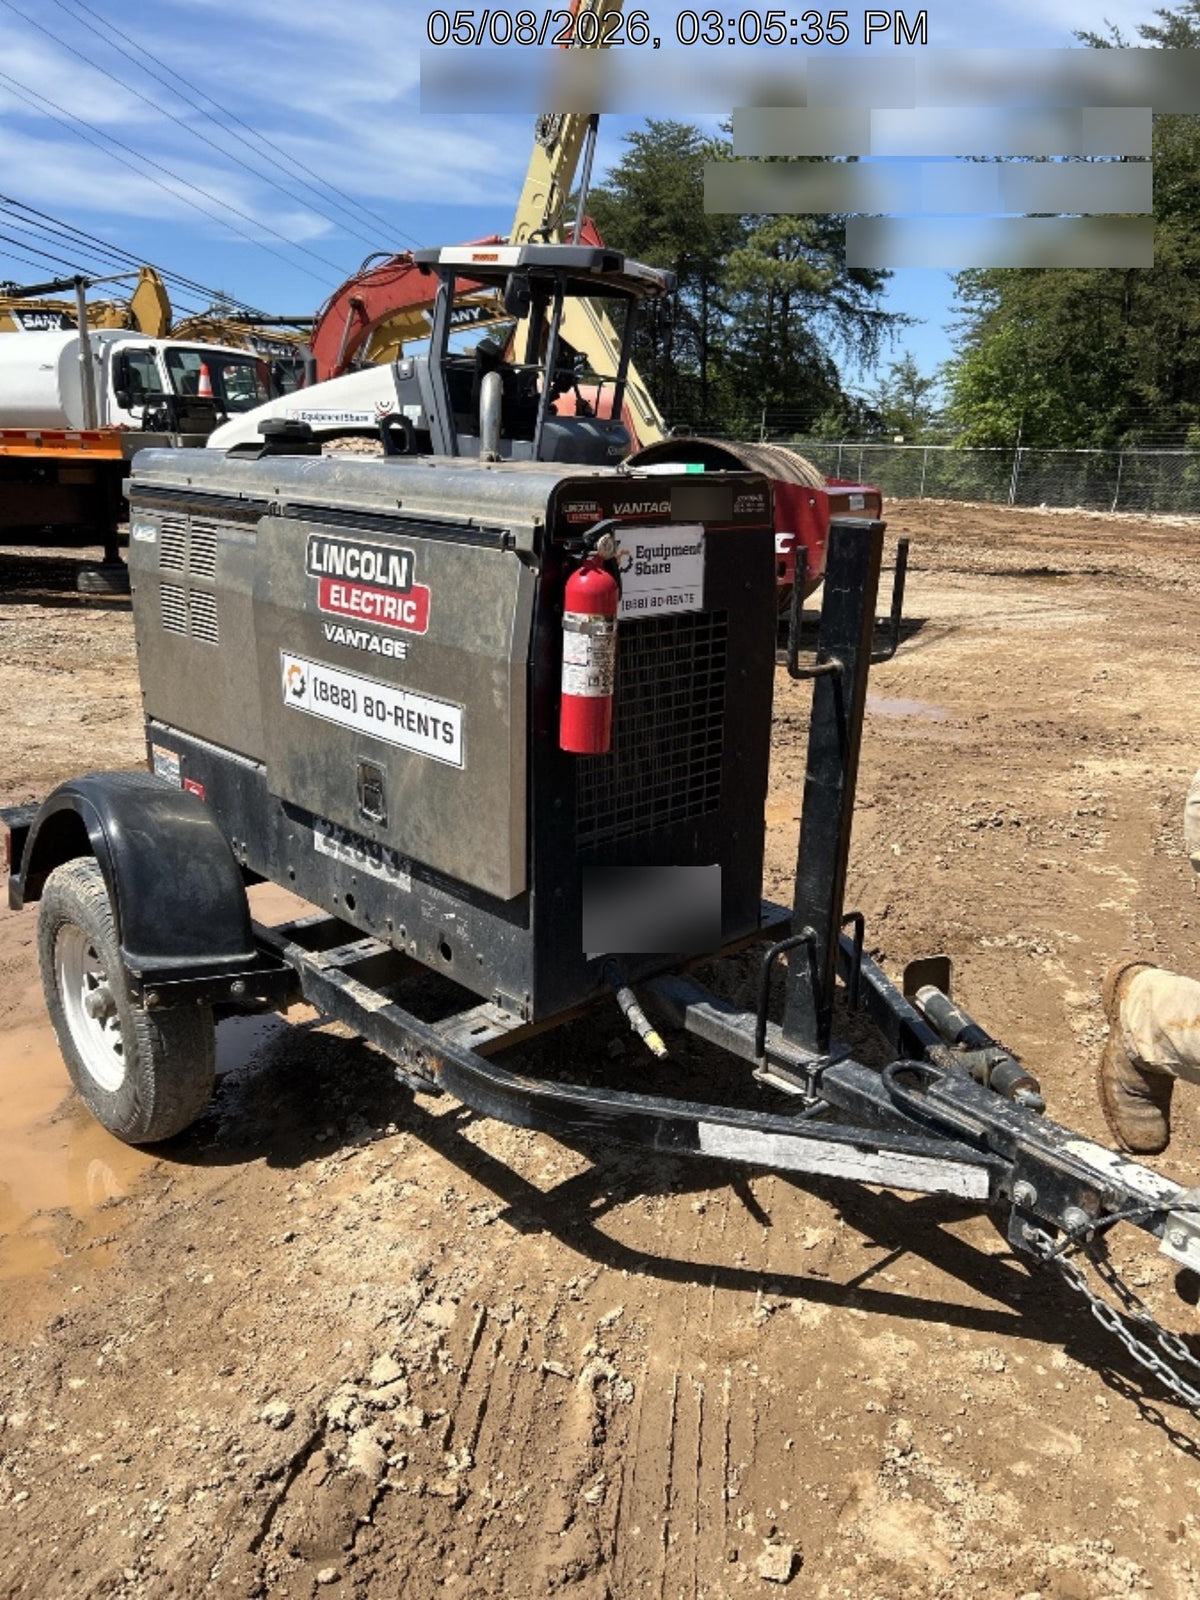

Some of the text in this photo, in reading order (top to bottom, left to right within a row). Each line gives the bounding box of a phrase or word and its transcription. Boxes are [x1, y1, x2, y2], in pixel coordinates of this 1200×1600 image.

[450, 307, 481, 323] ANY
[612, 501, 672, 514] VANTAG
[309, 541, 409, 588] LINCOLN
[635, 540, 702, 561] Equipment
[634, 561, 672, 576] Share
[329, 584, 417, 624] ELECTRIC
[322, 622, 408, 660] VANTAGE
[313, 676, 456, 745] (888) 80-RENTS
